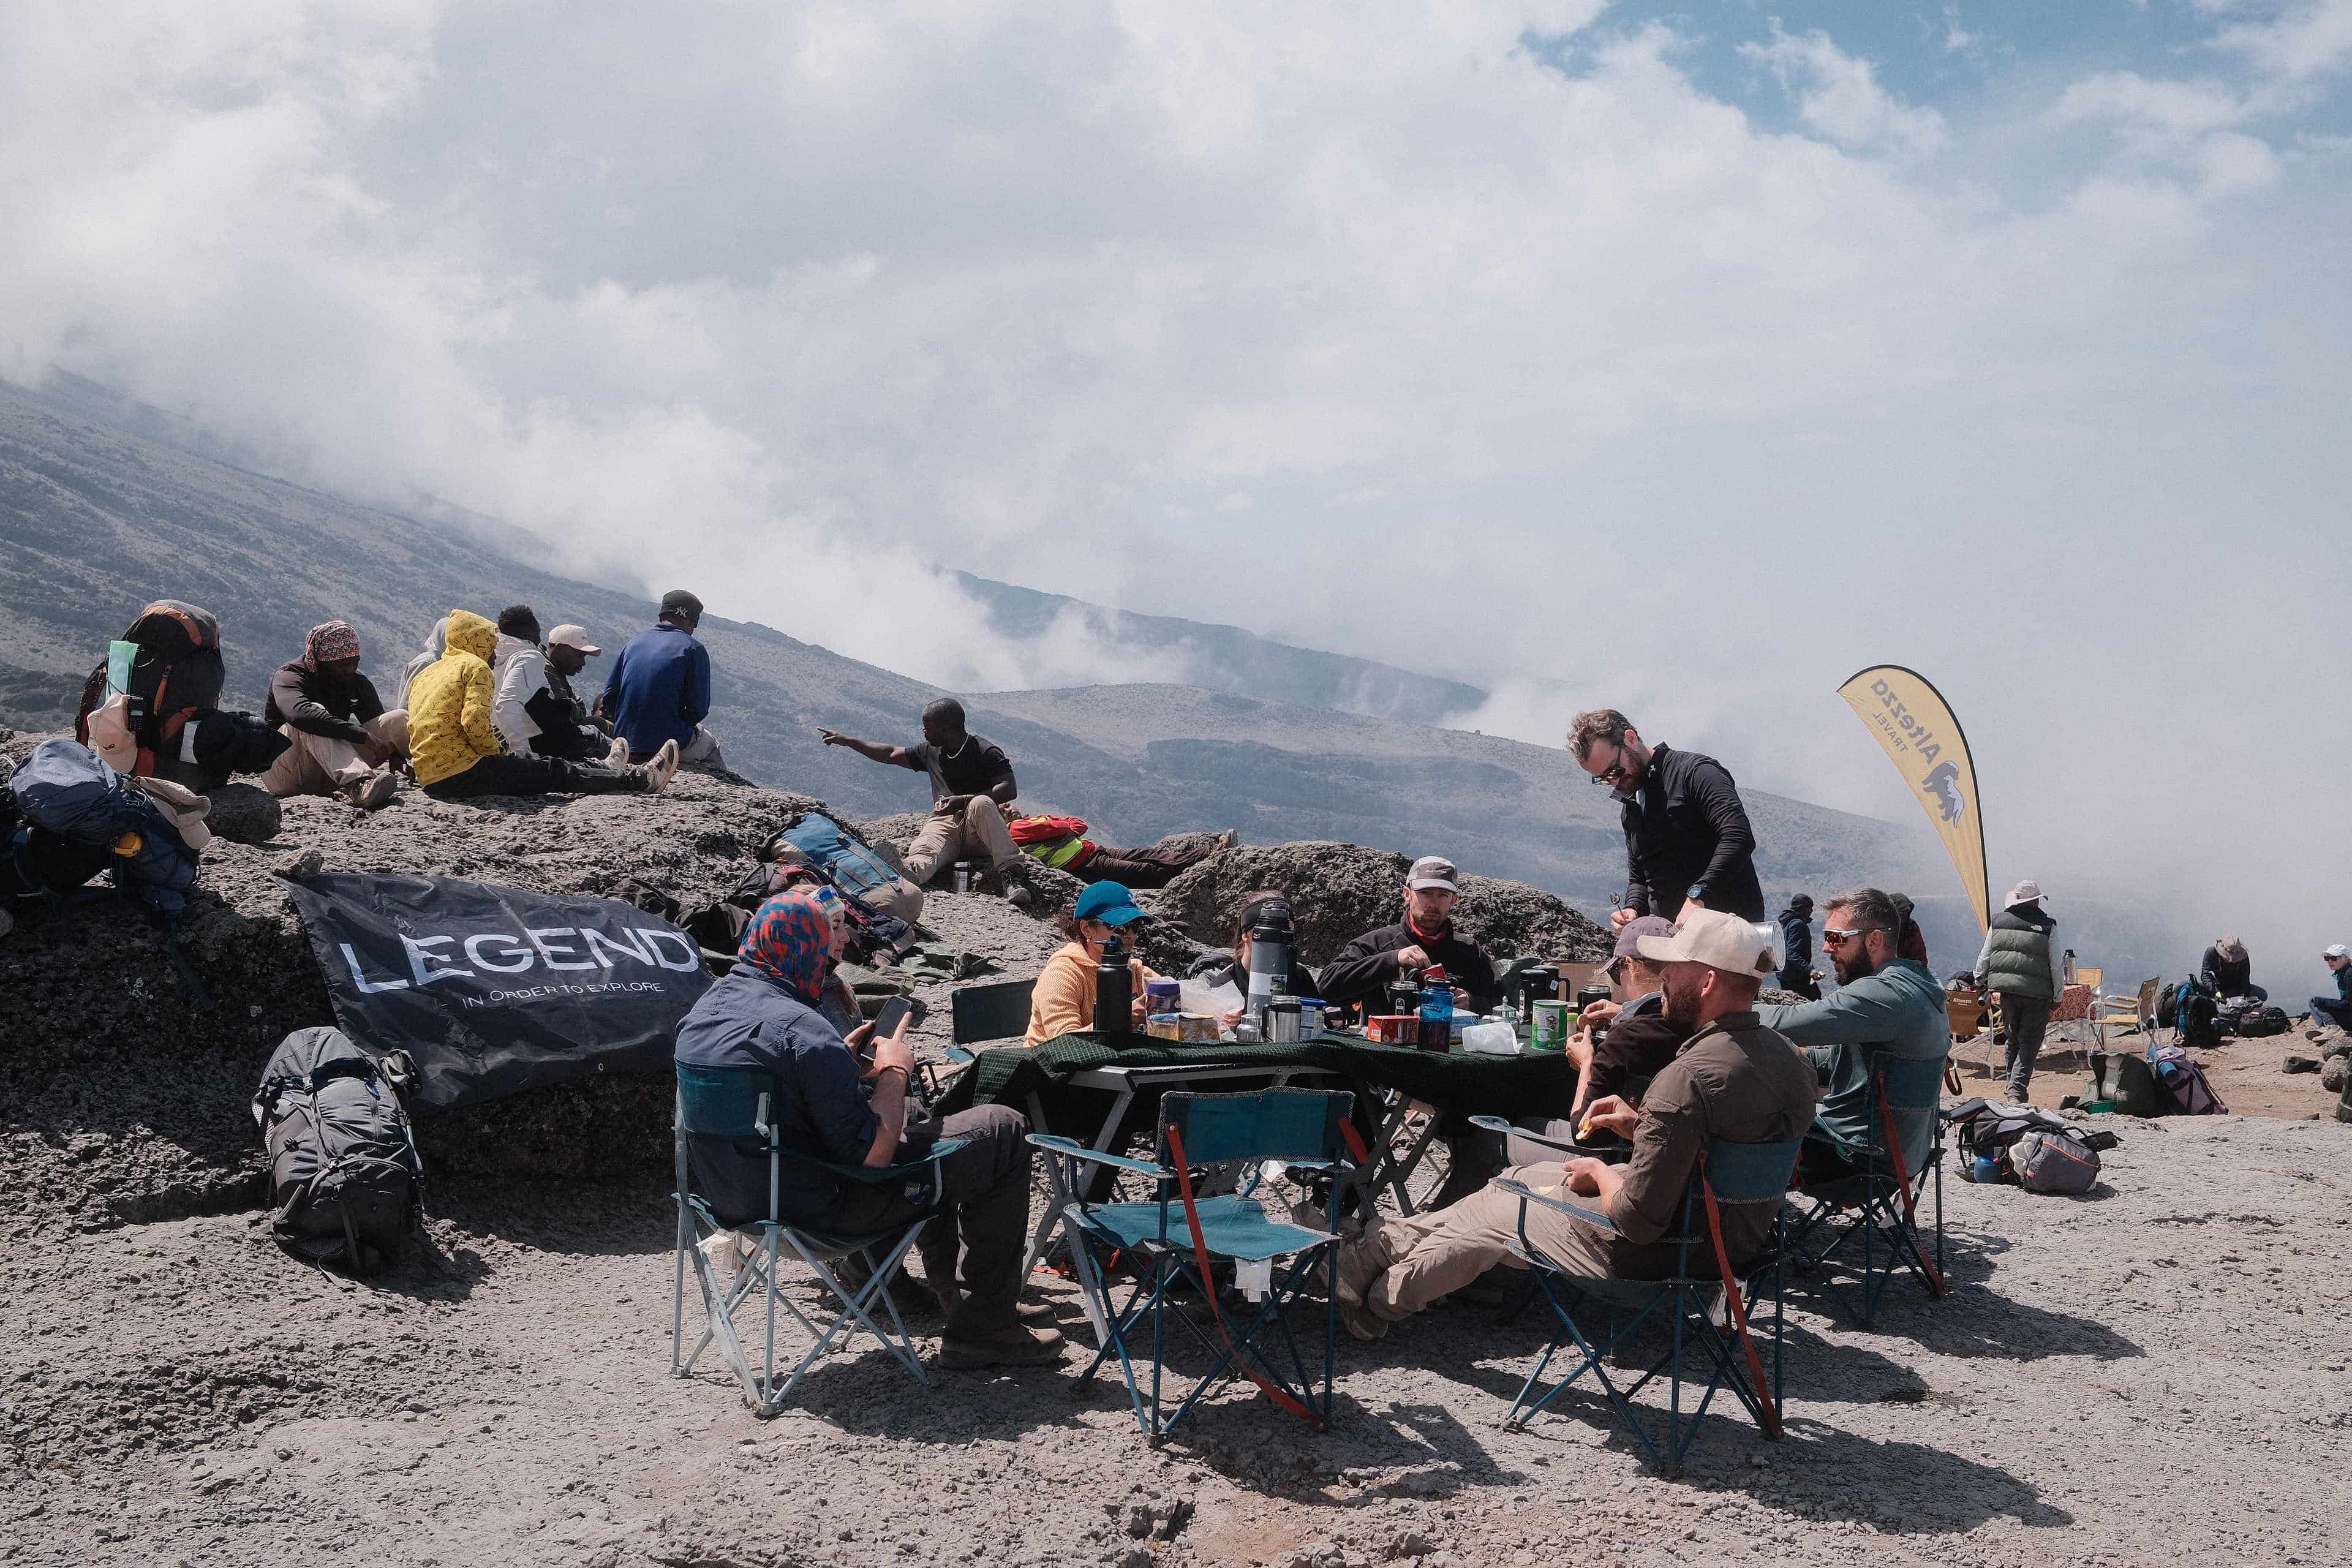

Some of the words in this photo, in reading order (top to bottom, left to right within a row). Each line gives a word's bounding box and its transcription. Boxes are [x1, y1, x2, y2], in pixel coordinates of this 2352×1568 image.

[339, 926, 700, 994] LEGEND
[462, 995, 484, 1009] IN
[490, 985, 559, 1001] ORDER
[559, 984, 584, 994] TO
[587, 982, 665, 993] EXPLORE
